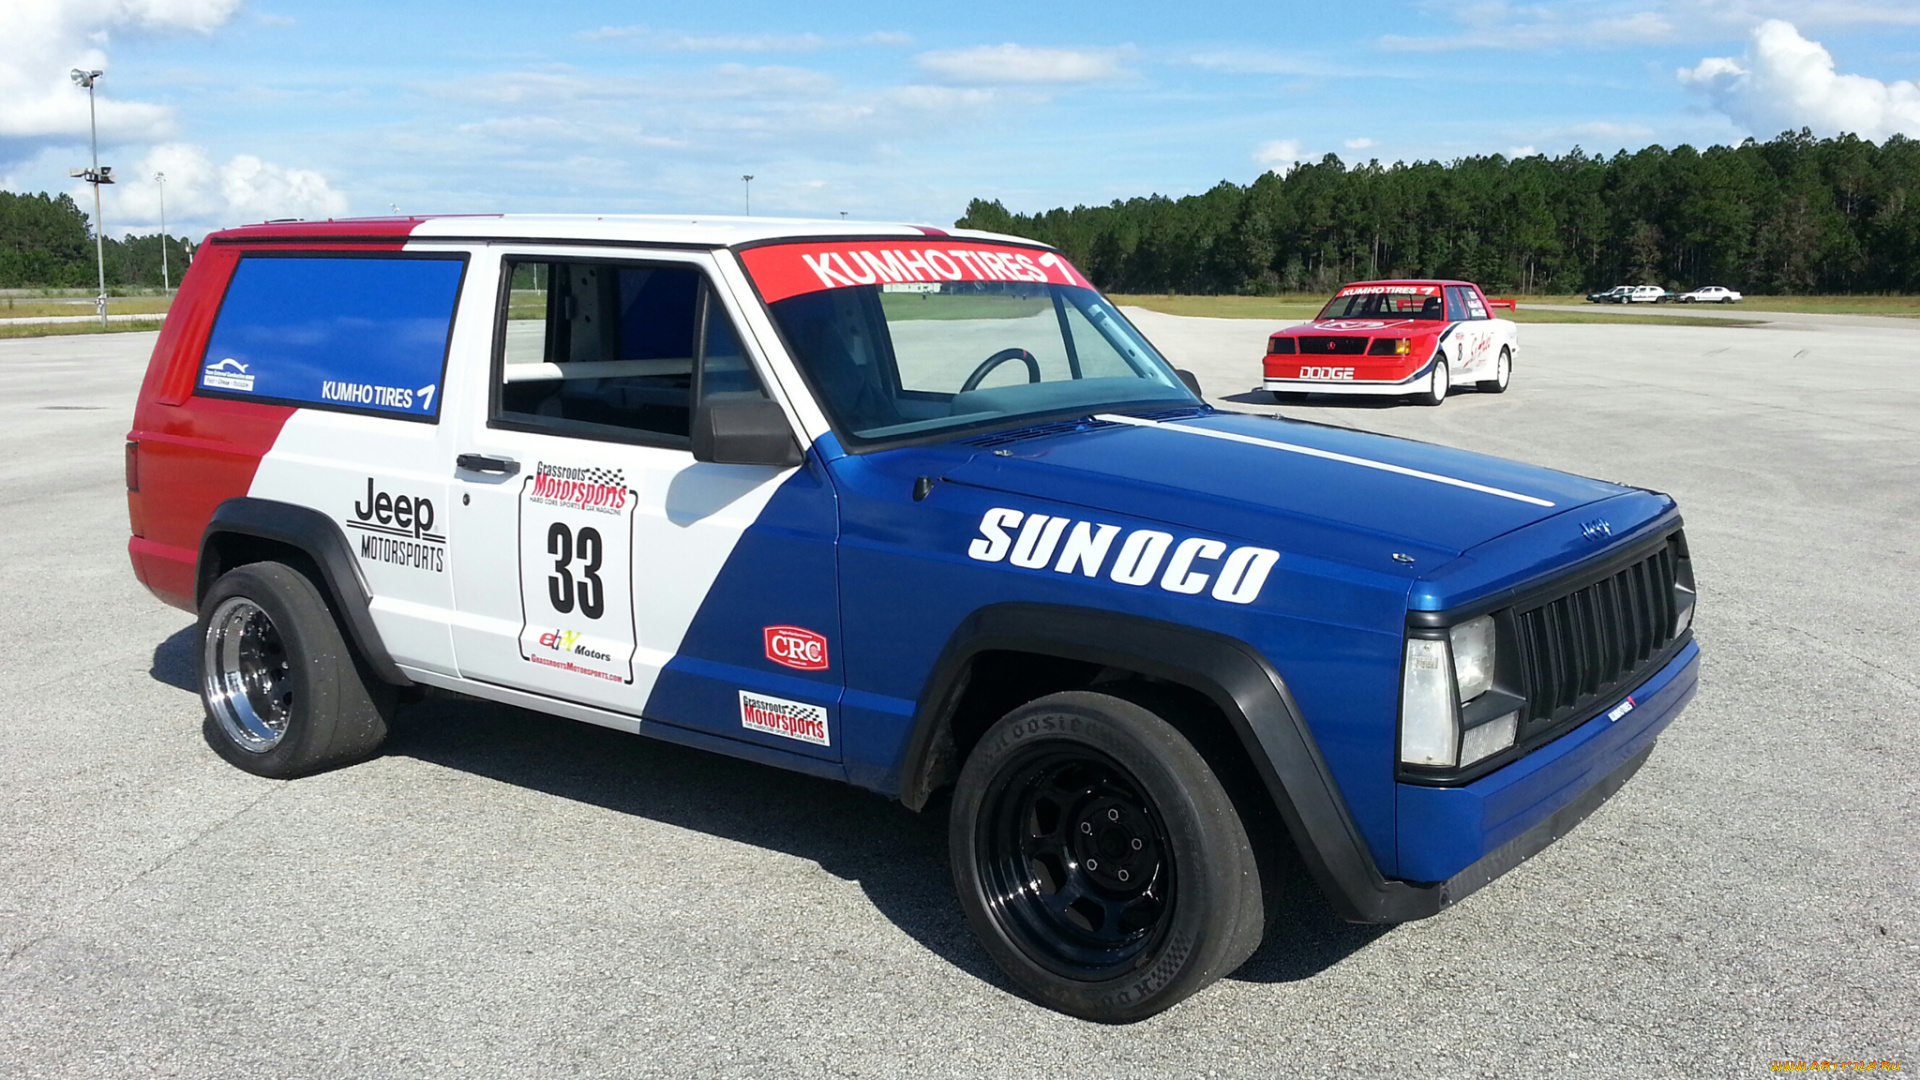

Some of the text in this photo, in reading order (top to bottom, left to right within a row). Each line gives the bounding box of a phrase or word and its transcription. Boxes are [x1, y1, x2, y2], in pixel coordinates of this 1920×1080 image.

[802, 249, 1048, 288] KUMHO TIRES
[1342, 286, 1417, 296] KUMHO TIRES
[1457, 343, 1463, 361] 8
[1299, 366, 1355, 380] DODGE
[322, 380, 413, 408] KUMHO TIRES
[537, 461, 586, 482] Grassroots
[531, 473, 626, 510] Motorsports
[355, 477, 434, 539] Jeep
[545, 498, 558, 506] CORE
[560, 501, 580, 510] SPORTS
[586, 504, 595, 512] CAR
[596, 506, 621, 516] MAGAZINE
[361, 534, 444, 573] MOTORSPORTS
[967, 507, 1281, 605] SUNOCO
[547, 522, 604, 620] 33
[574, 645, 611, 662] Motors
[771, 635, 822, 662] CRC
[743, 695, 787, 714] Grassroots
[744, 705, 824, 739] Motorsports
